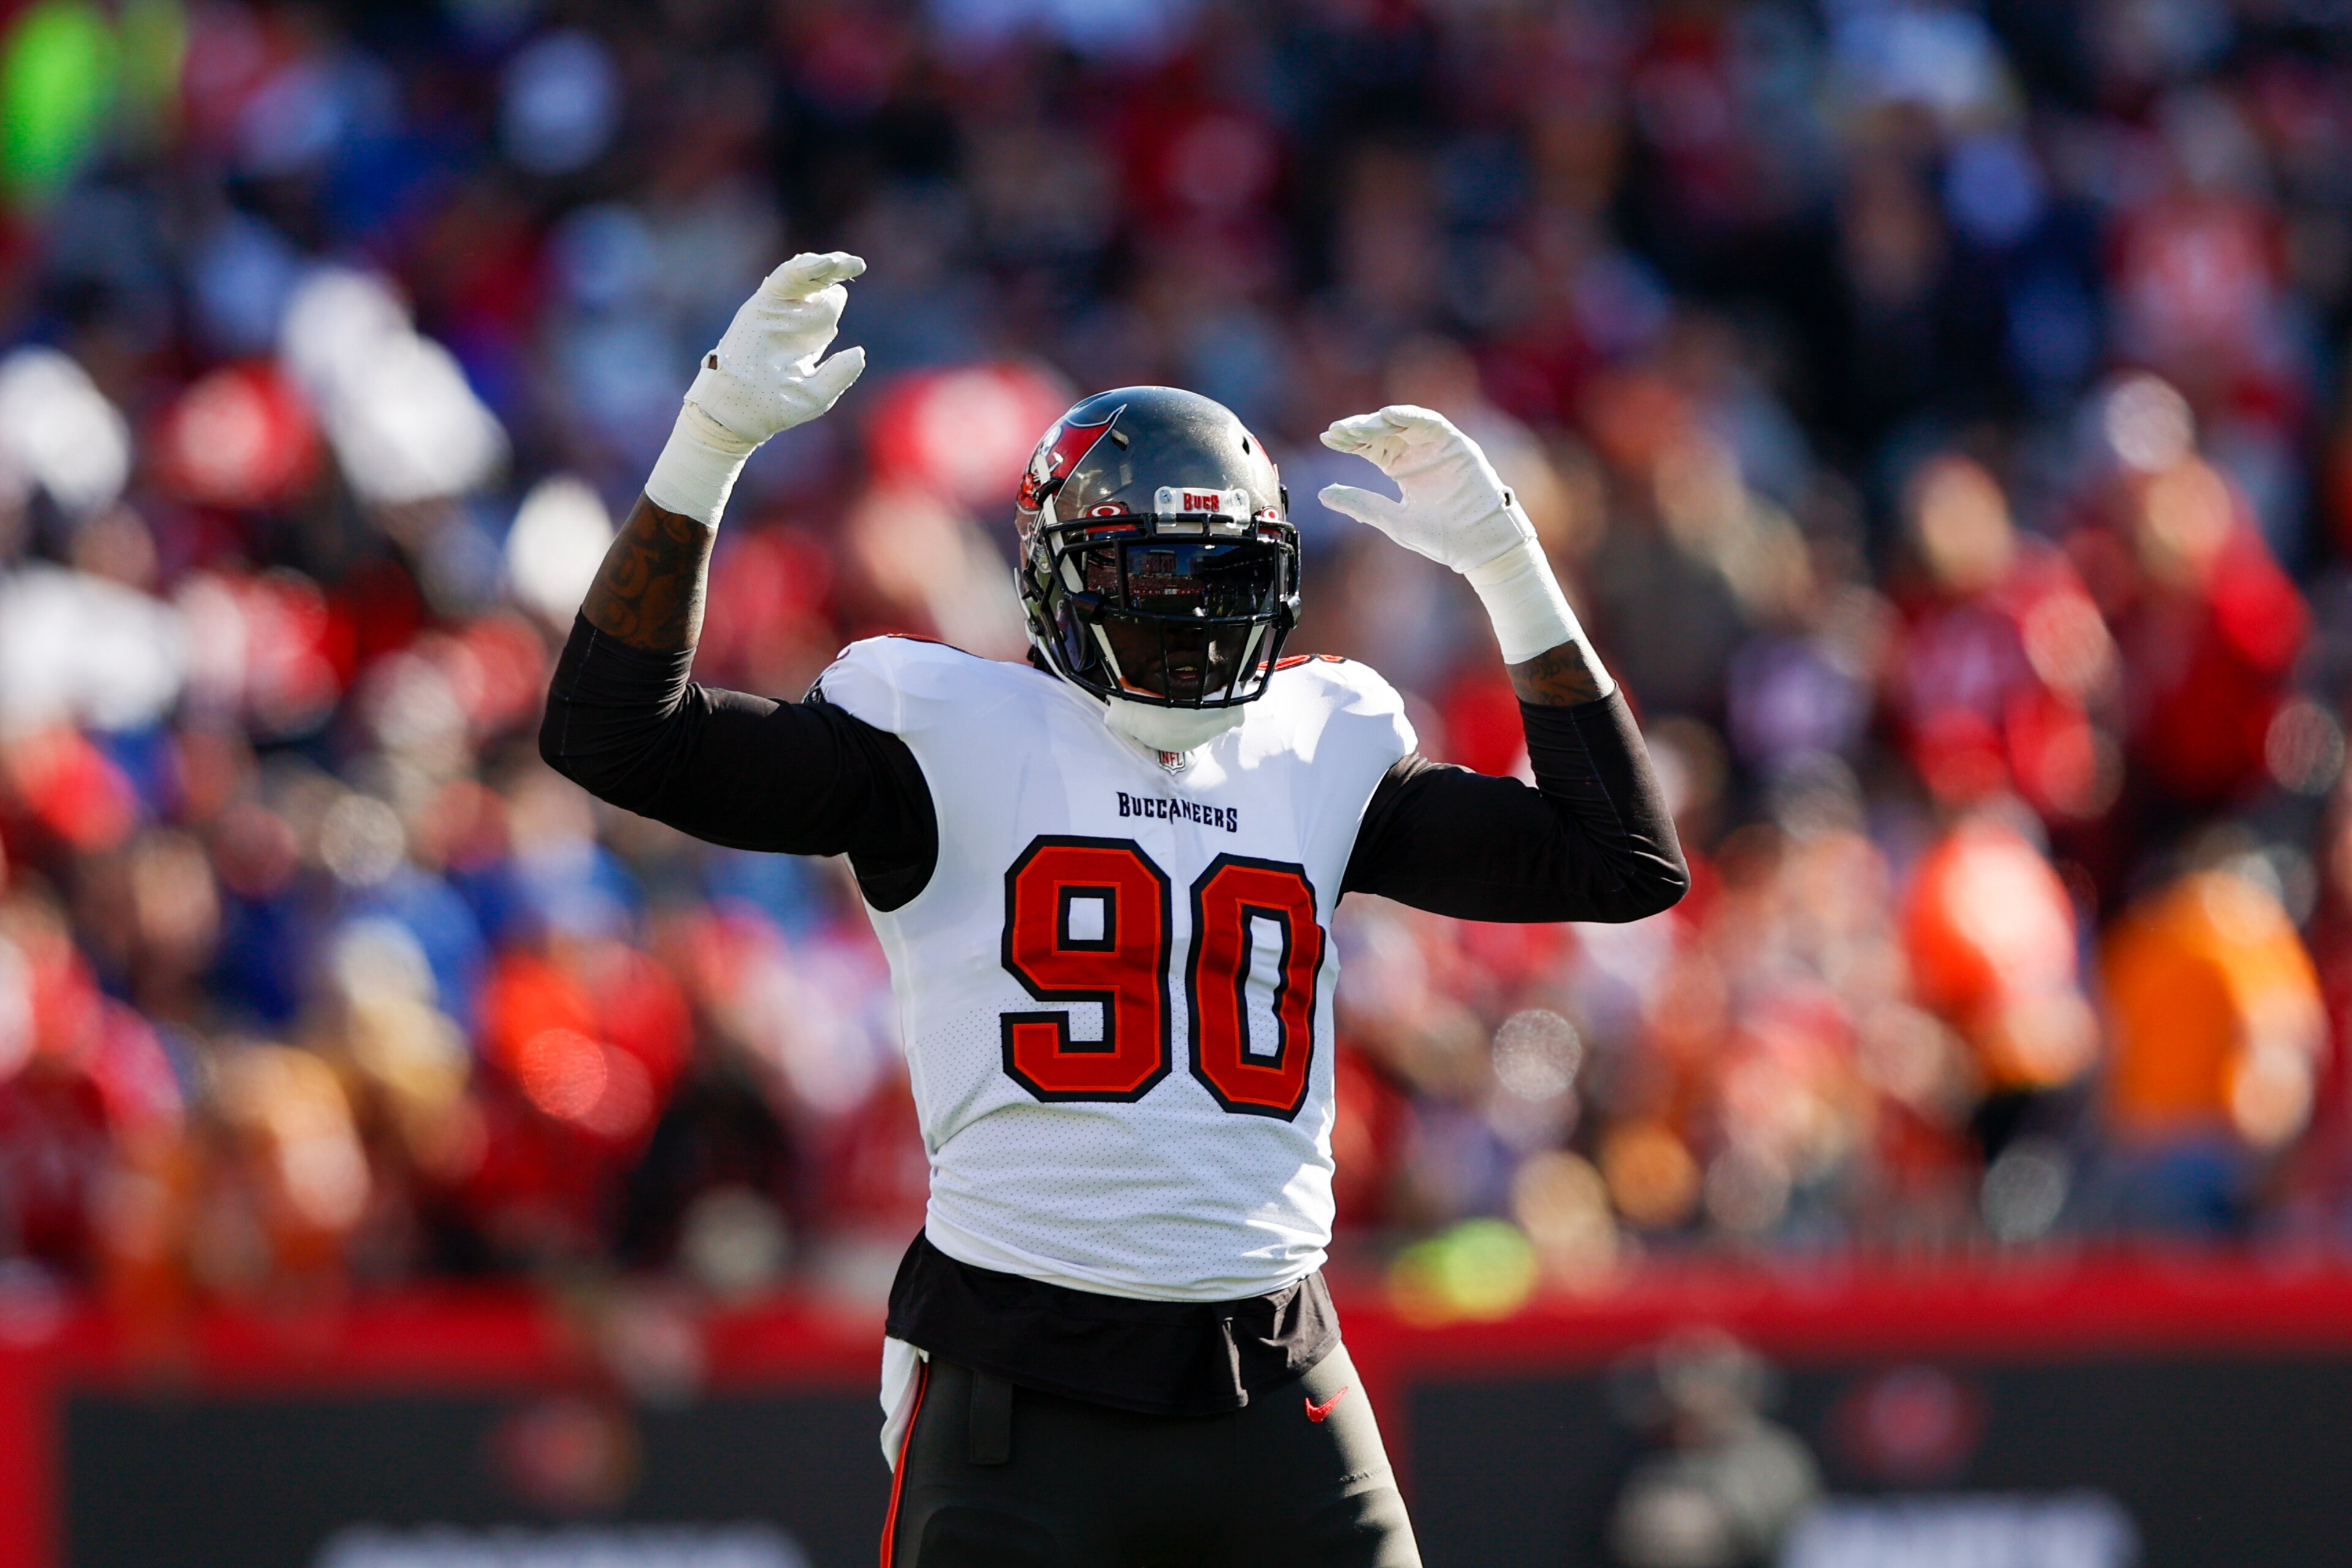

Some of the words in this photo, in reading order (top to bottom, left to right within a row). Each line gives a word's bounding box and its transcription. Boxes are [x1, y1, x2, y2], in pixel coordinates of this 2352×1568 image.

[1161, 750, 1183, 766] NFL
[1116, 791, 1237, 833] BUCCANEERS
[1000, 835, 1326, 1123] 90
